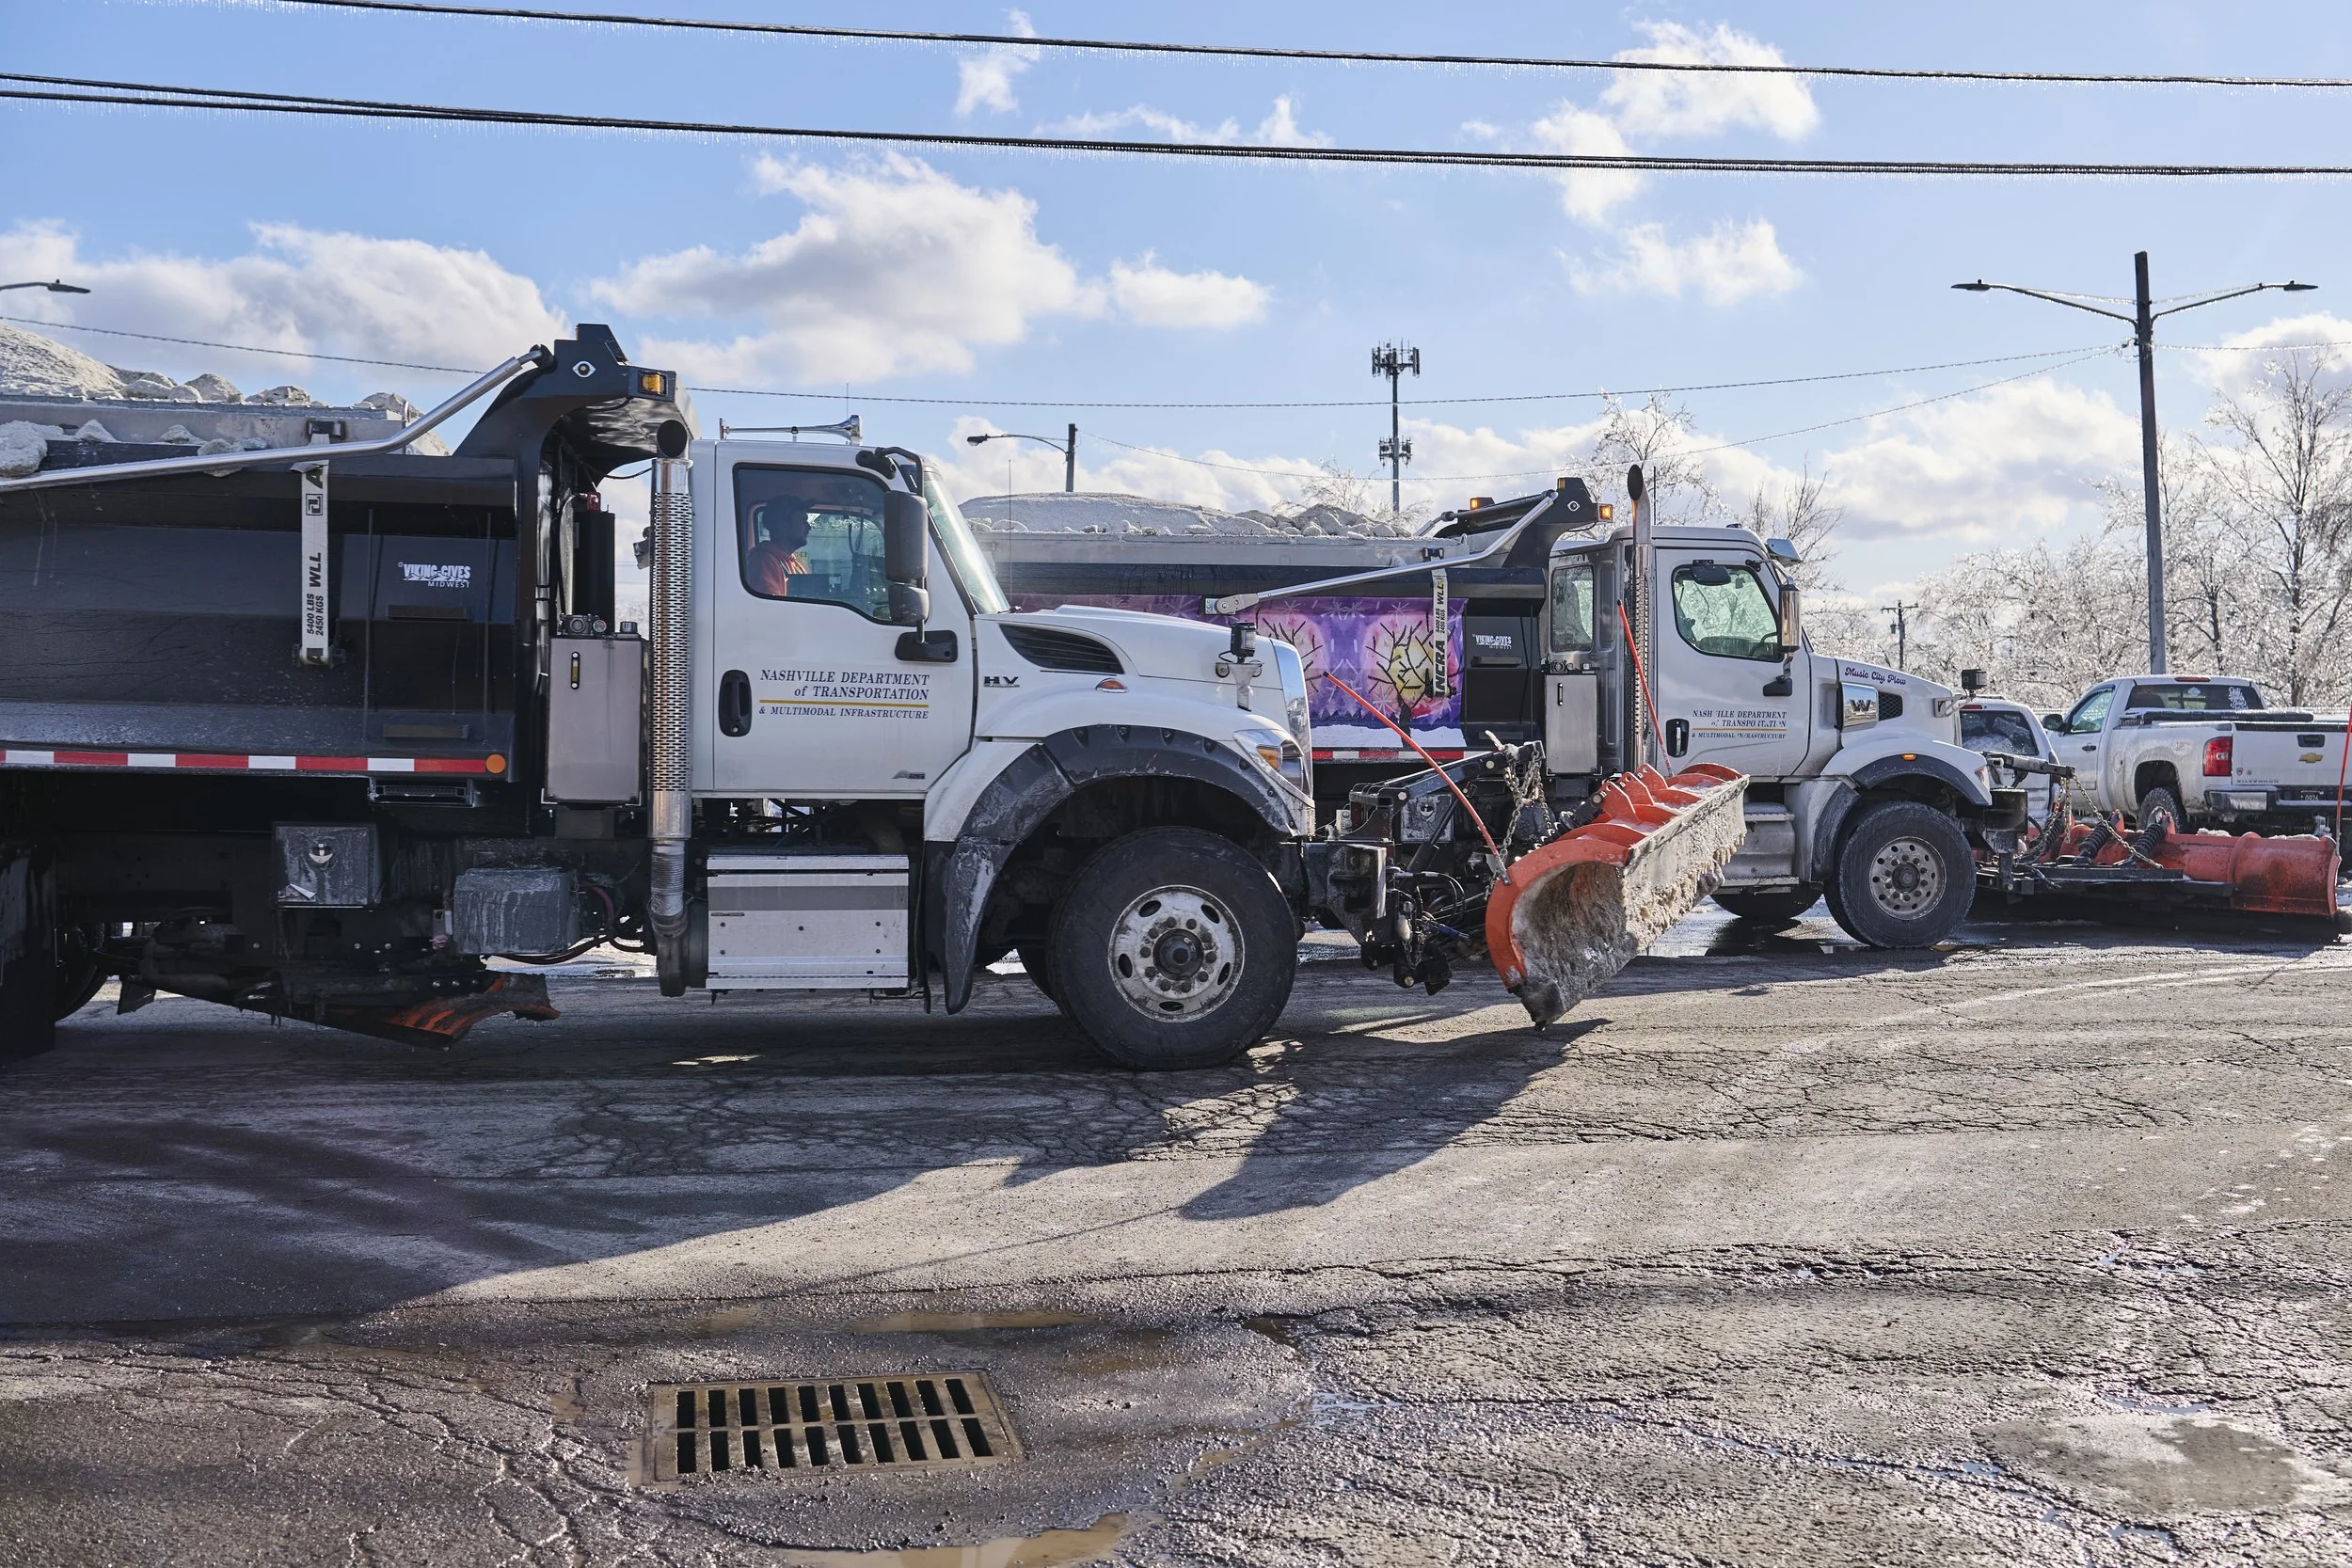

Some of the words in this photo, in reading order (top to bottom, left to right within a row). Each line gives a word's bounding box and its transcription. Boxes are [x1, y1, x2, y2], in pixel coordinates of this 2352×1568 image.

[310, 552, 321, 587] WLL
[315, 595, 324, 613] KGS
[315, 616, 324, 636] 2450
[760, 669, 835, 683] NASHVILLE
[840, 672, 930, 686] DEPARTMENT
[984, 676, 1019, 685] HV
[1845, 667, 1869, 679] Music
[1871, 671, 1885, 684] City
[1887, 673, 1906, 685] Plow
[794, 686, 808, 697] of
[813, 686, 930, 701] TRANSPORTATION
[758, 705, 766, 715] &
[771, 706, 836, 717] MULTIMODAL
[840, 707, 930, 720] INFRASTRUCTURE
[1692, 709, 1735, 719] NASHILLE
[1738, 710, 1788, 719] DEPARTMENT
